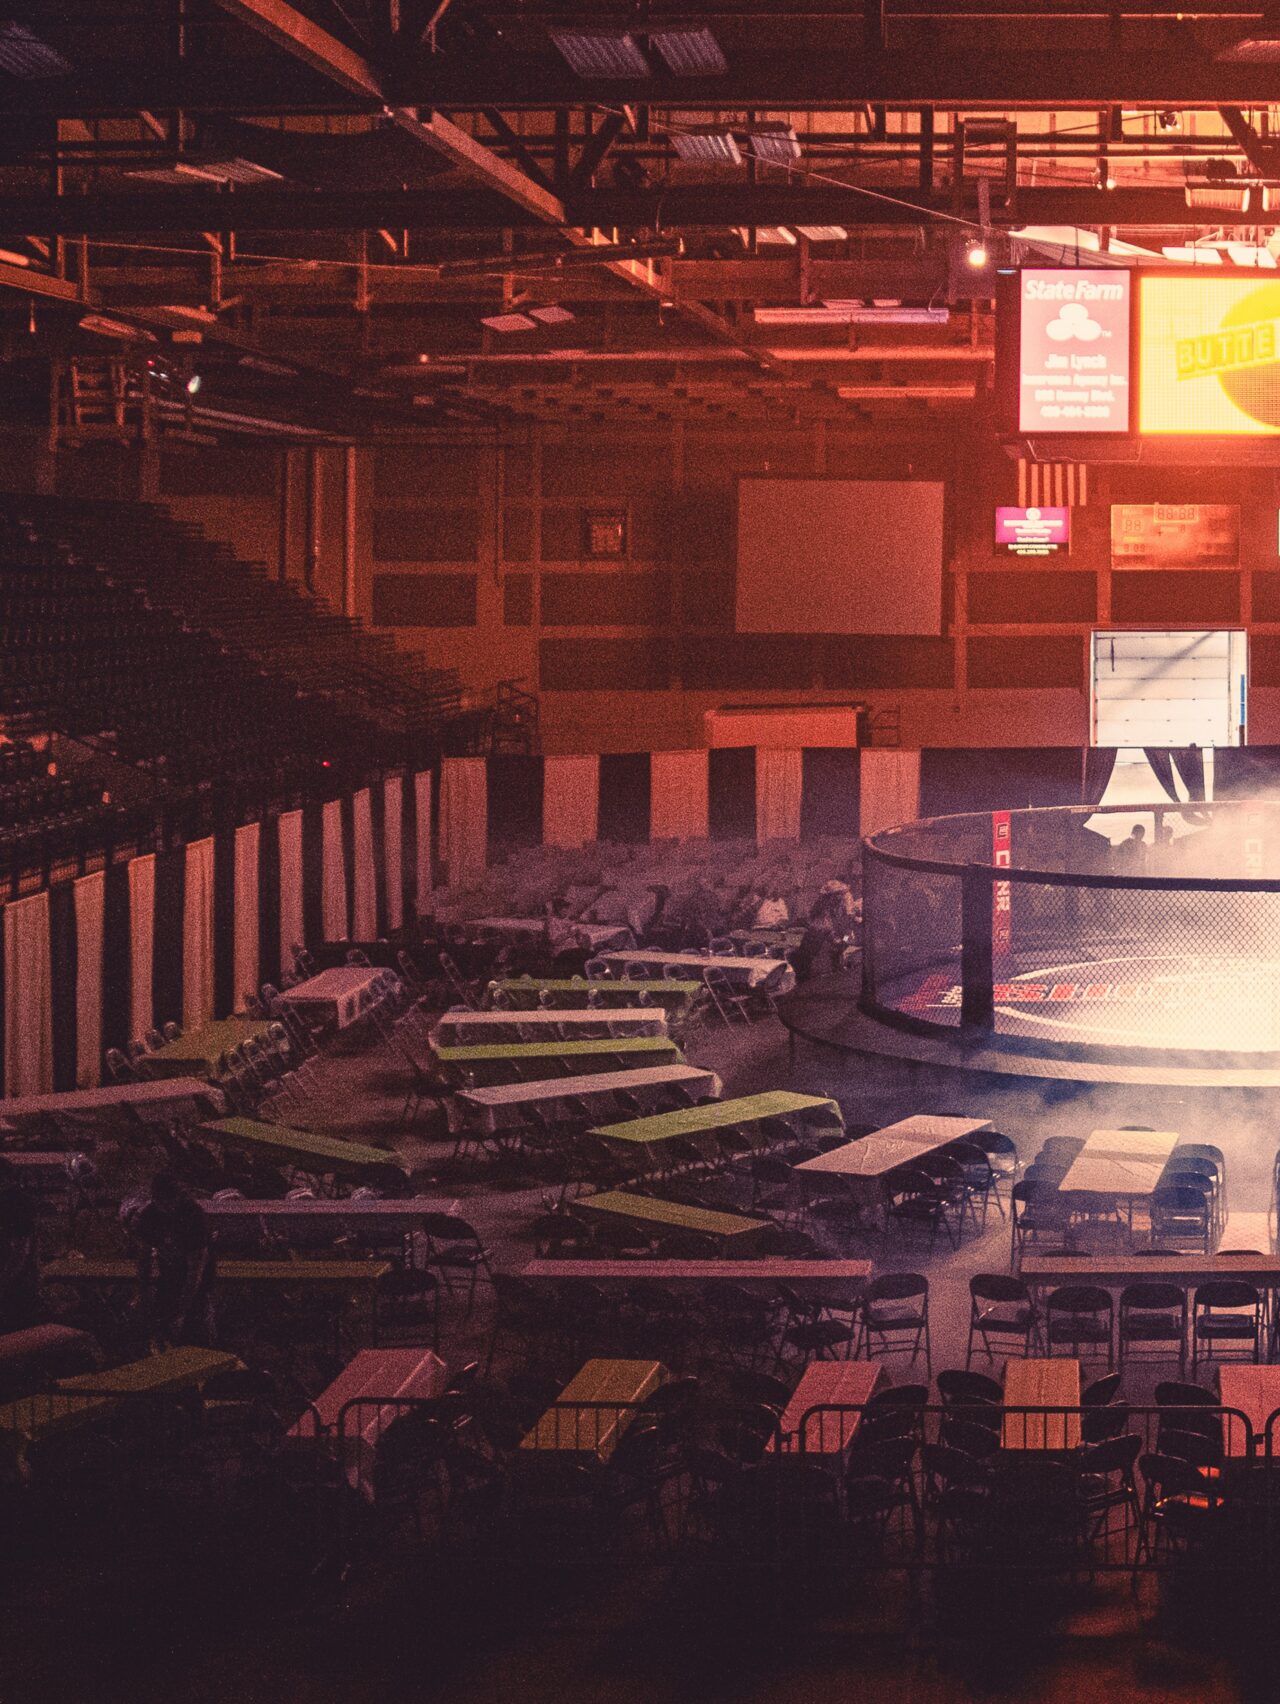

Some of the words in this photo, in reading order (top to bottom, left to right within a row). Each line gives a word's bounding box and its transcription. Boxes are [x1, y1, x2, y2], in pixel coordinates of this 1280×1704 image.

[1025, 279, 1075, 300] State
[1075, 280, 1123, 300] Farm
[1178, 323, 1275, 373] BUTTE
